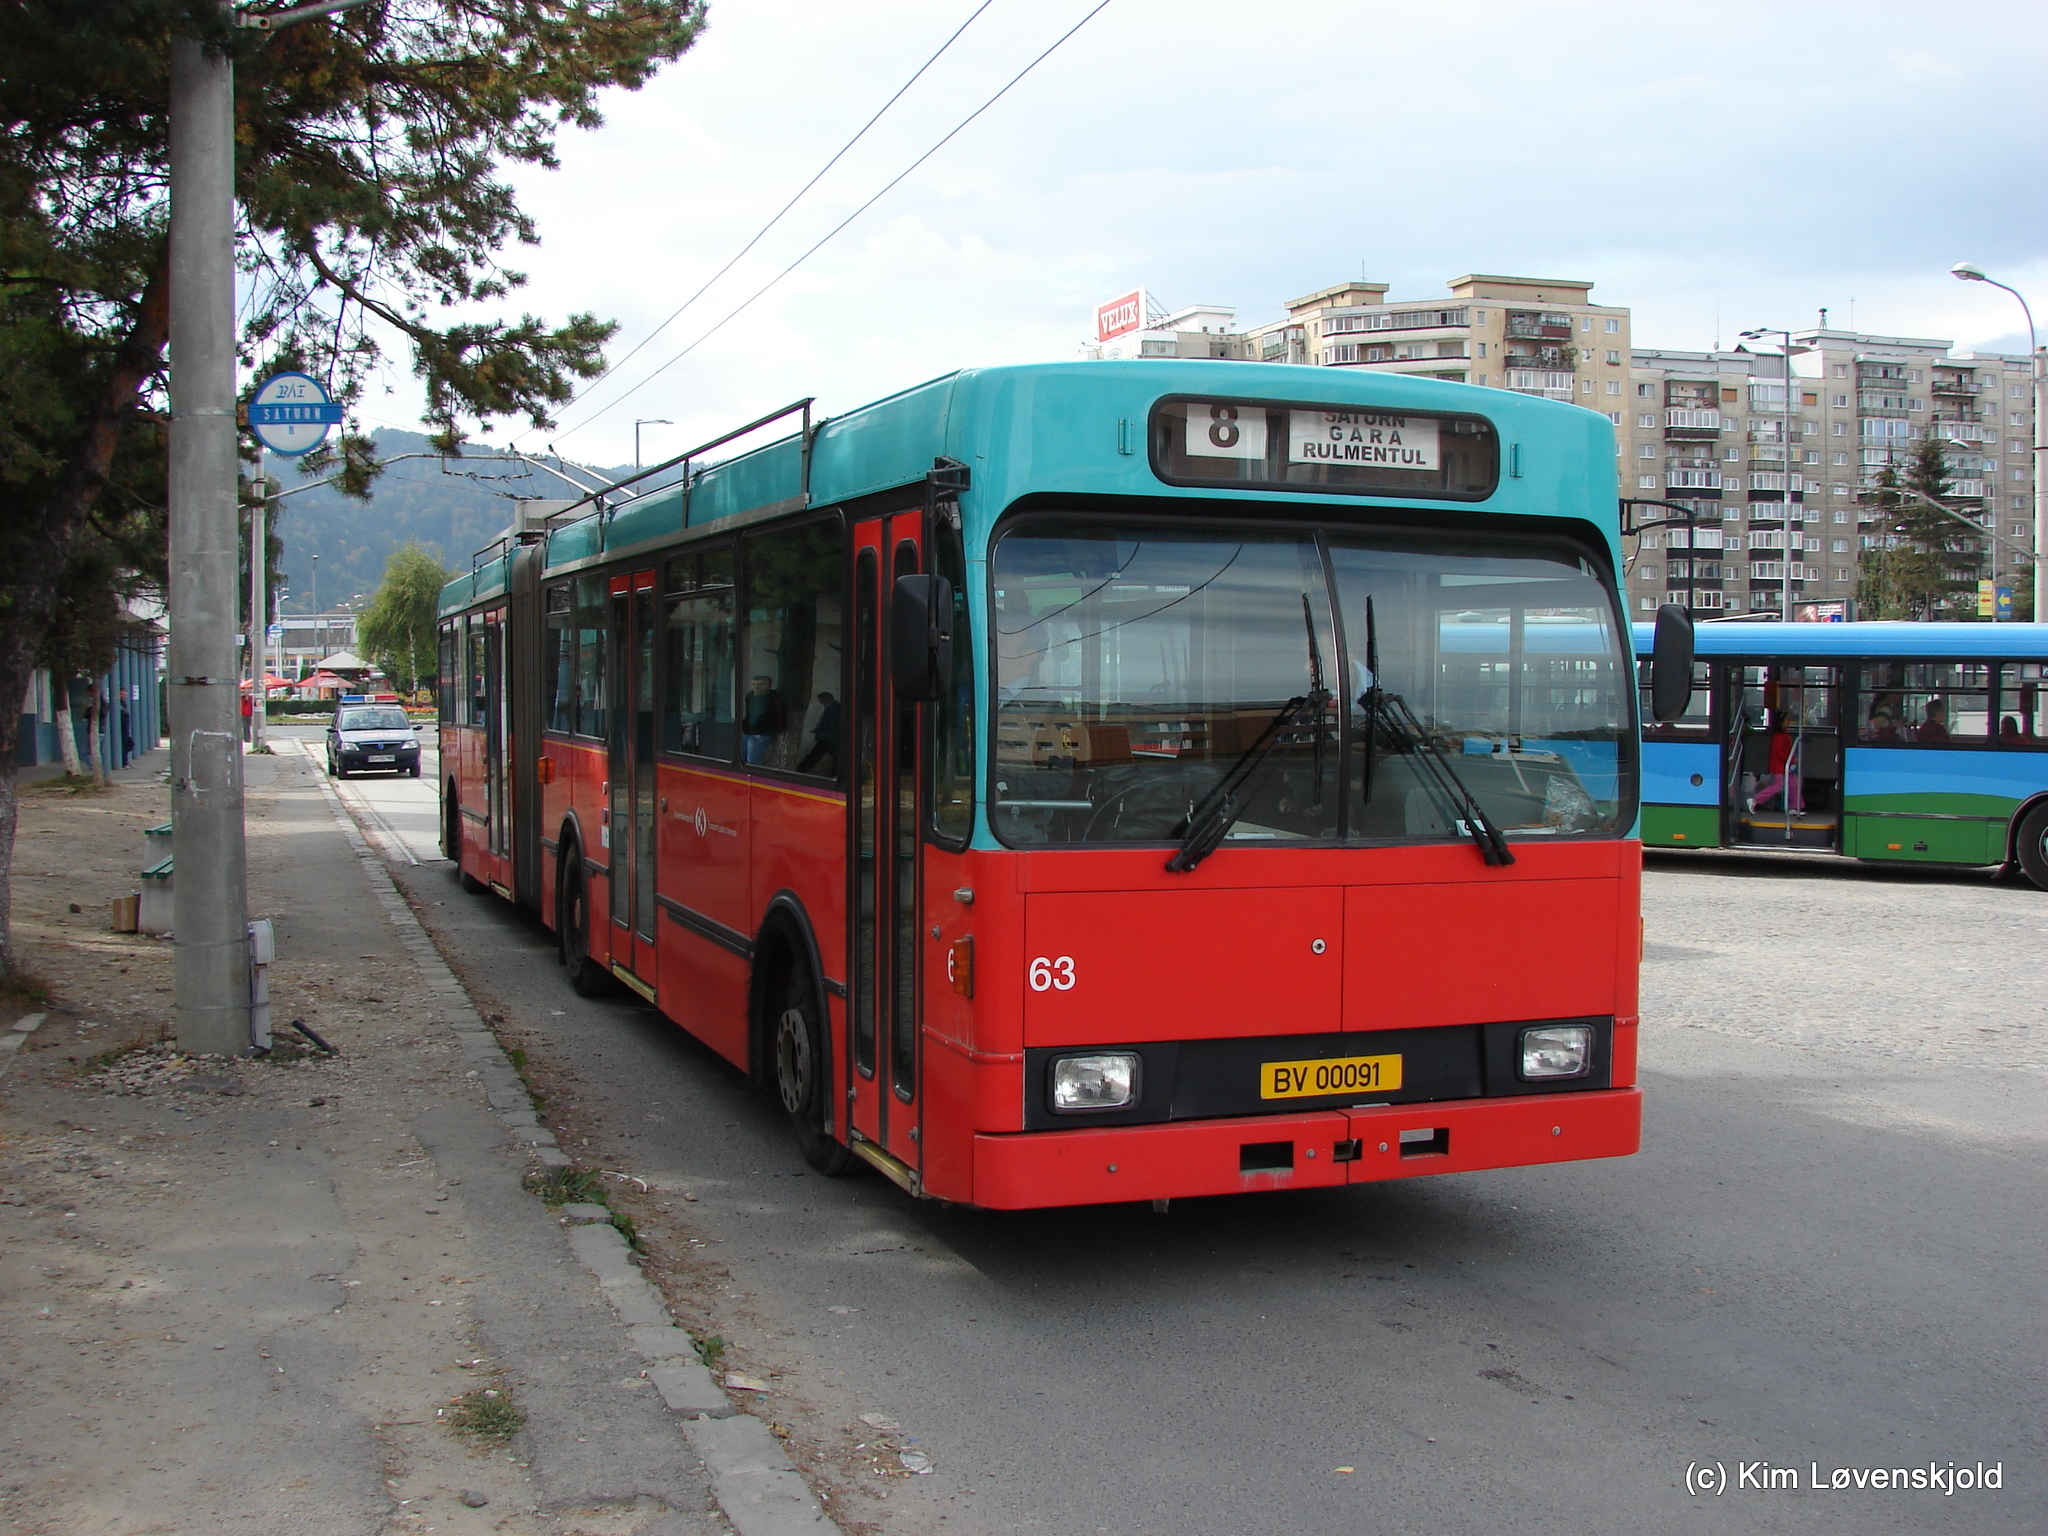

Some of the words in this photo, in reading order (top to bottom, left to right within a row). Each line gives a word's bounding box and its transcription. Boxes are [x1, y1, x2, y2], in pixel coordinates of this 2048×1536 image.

[1100, 300, 1137, 334] VELUX
[264, 407, 321, 420] SATURN
[1208, 404, 1240, 449] 8
[1324, 412, 1405, 428] SATURN
[1303, 442, 1426, 465] RULMENTUL
[1029, 956, 1076, 992] 63
[1274, 1066, 1308, 1094] BV
[1316, 1062, 1380, 1090] 00091
